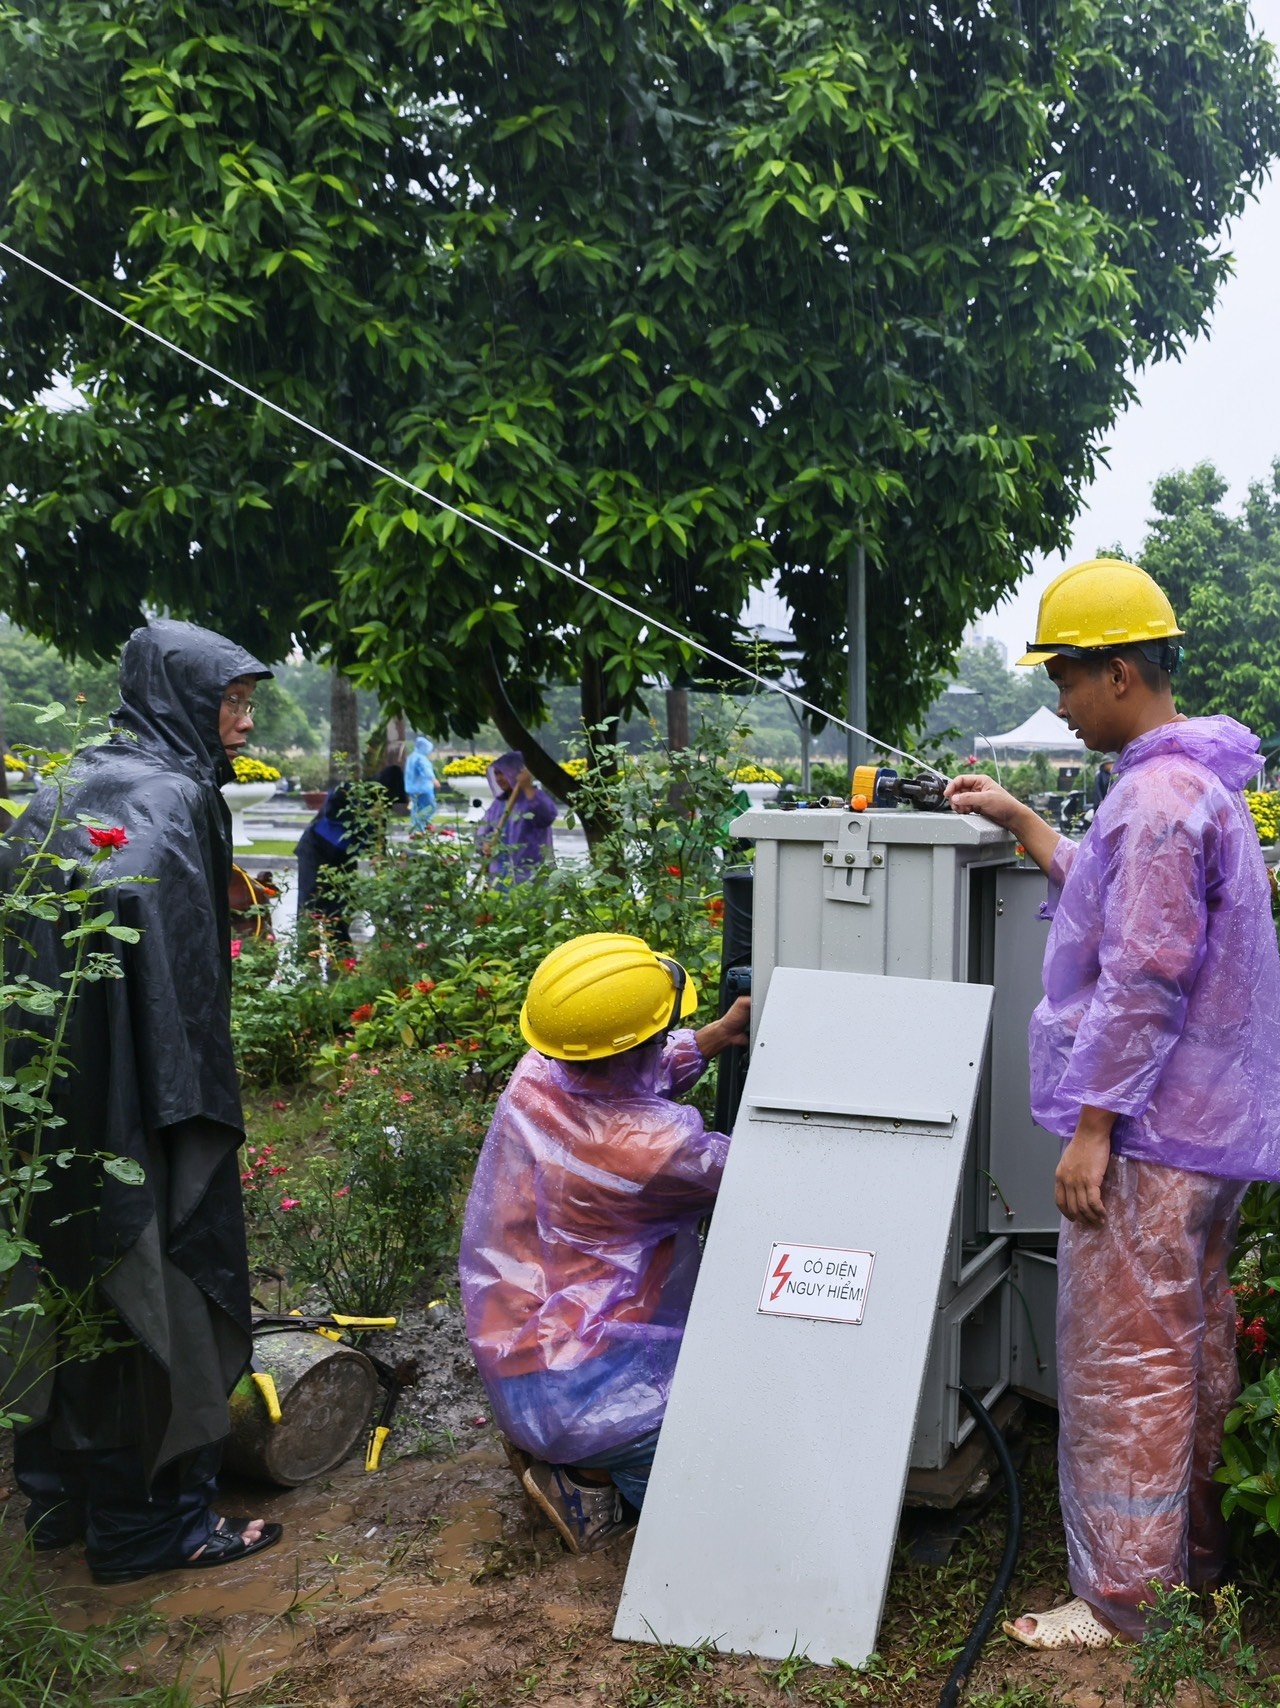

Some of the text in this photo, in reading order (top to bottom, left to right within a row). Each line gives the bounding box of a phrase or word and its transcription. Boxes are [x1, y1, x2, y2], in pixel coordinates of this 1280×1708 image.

[804, 1258, 858, 1280] CÓ ĐIỆN
[786, 1280, 864, 1301] NGUY HIỂM!
